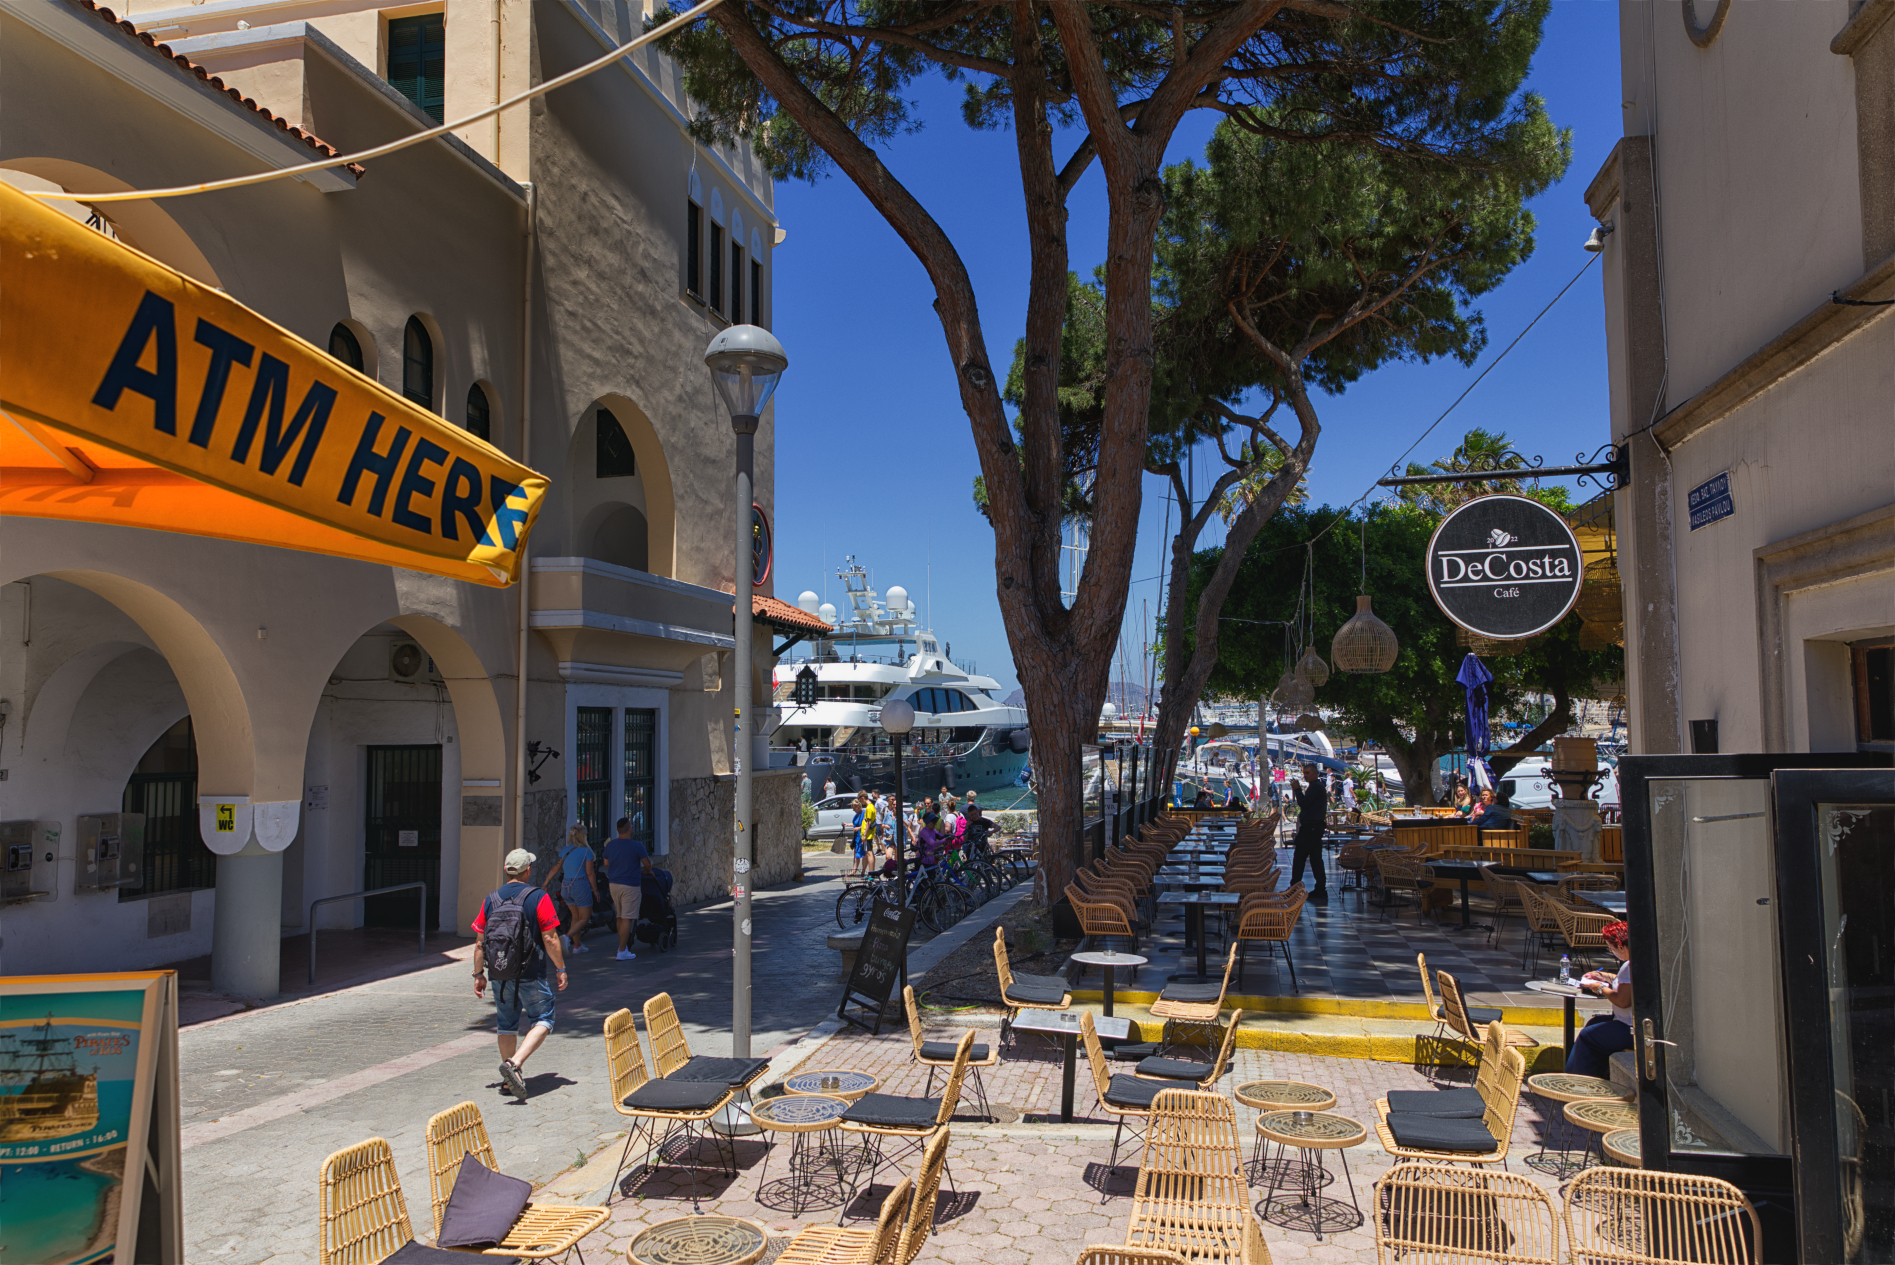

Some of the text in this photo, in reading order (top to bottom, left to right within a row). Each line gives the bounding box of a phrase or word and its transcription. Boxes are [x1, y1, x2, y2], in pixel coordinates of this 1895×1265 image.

[91, 290, 529, 553] ATM HERE
[1711, 499, 1731, 518] PAVLOU
[1440, 553, 1572, 582] DeCosta
[1493, 587, 1520, 599] Café
[218, 819, 234, 831] WC
[859, 963, 887, 984] gyros
[73, 1034, 131, 1049] PIRATES
[15, 1145, 40, 1156] 12:00
[49, 1138, 84, 1153] RETURN
